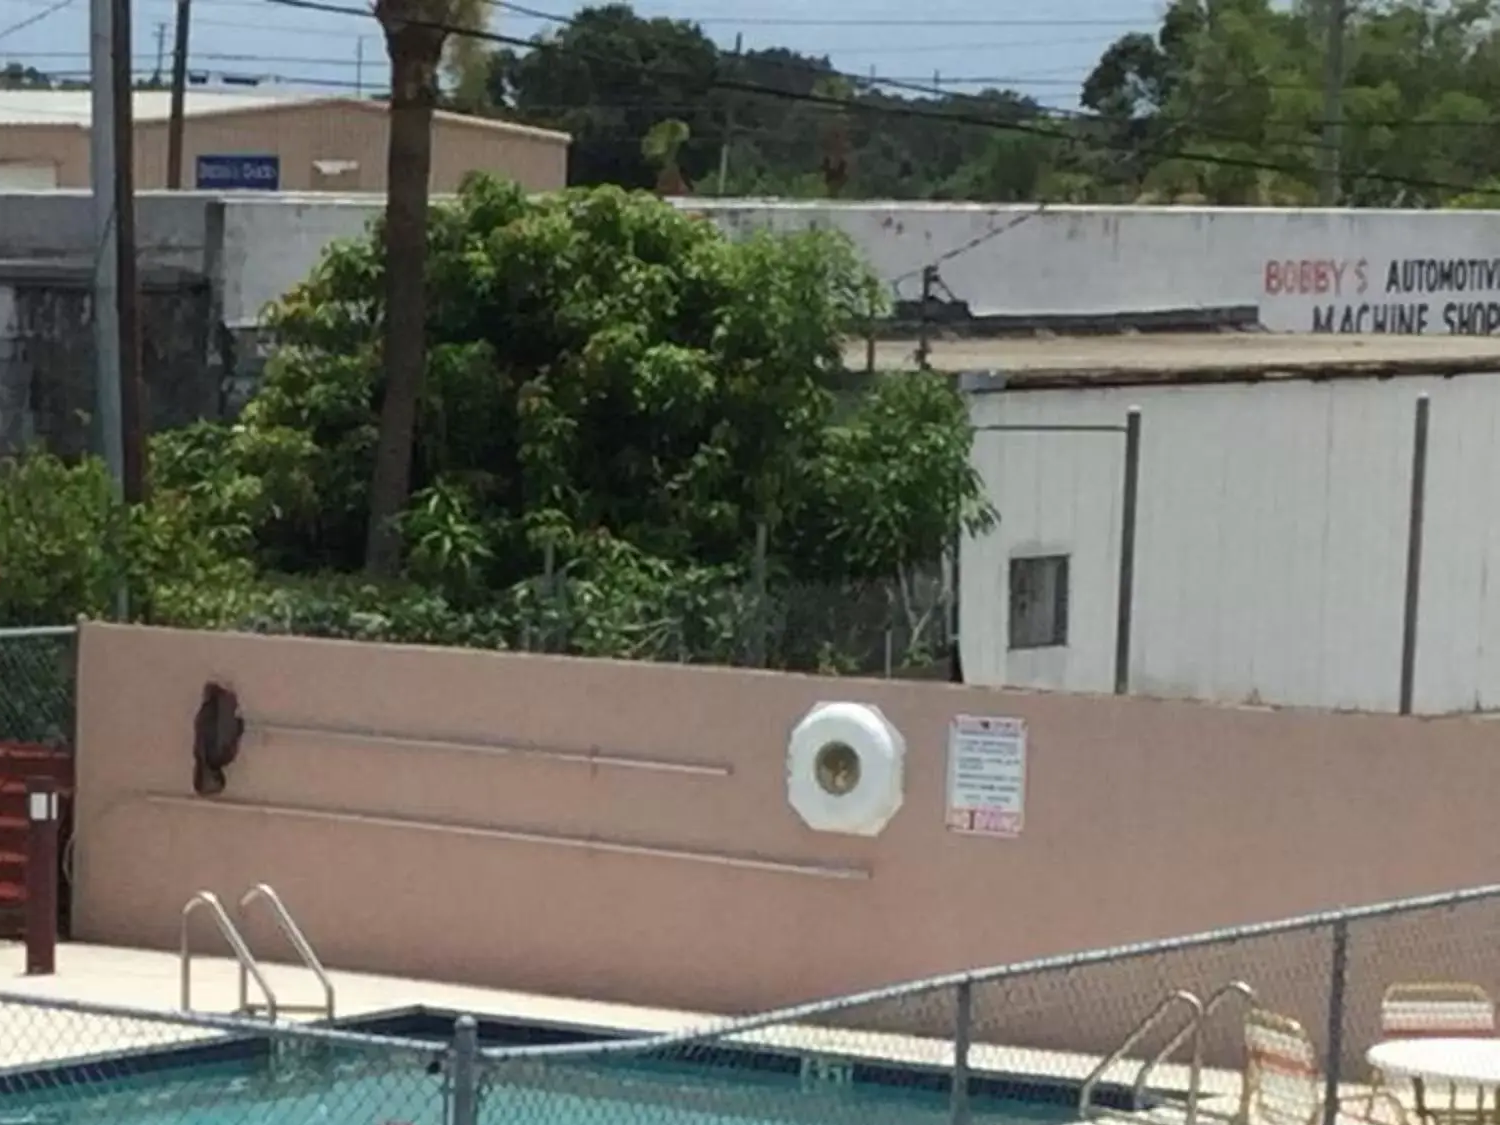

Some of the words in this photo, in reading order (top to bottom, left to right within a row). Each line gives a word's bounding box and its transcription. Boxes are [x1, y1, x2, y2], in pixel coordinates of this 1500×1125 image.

[1385, 257, 1500, 294] AUTOMOTIV
[1312, 302, 1429, 334] MACHINE
[1442, 302, 1500, 335] SHOP
